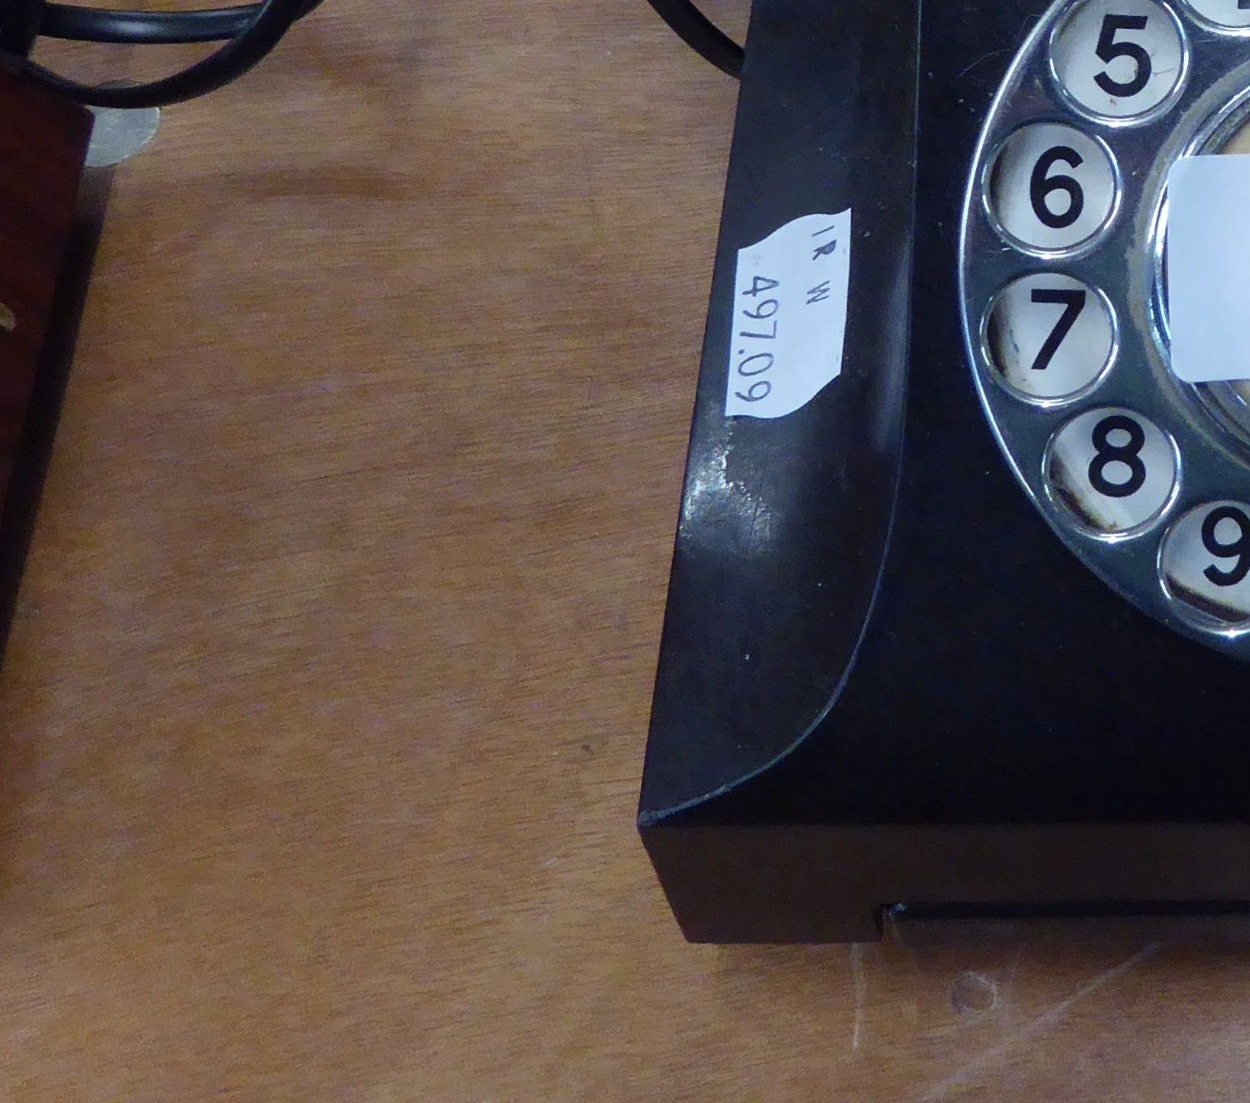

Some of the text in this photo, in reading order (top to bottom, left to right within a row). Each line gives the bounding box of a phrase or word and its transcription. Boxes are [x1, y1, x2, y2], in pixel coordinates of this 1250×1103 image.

[1092, 13, 1153, 98] 5
[1028, 145, 1085, 229] 6
[734, 274, 781, 403] 497.09
[1029, 288, 1087, 371] 7
[1088, 415, 1146, 498] 8
